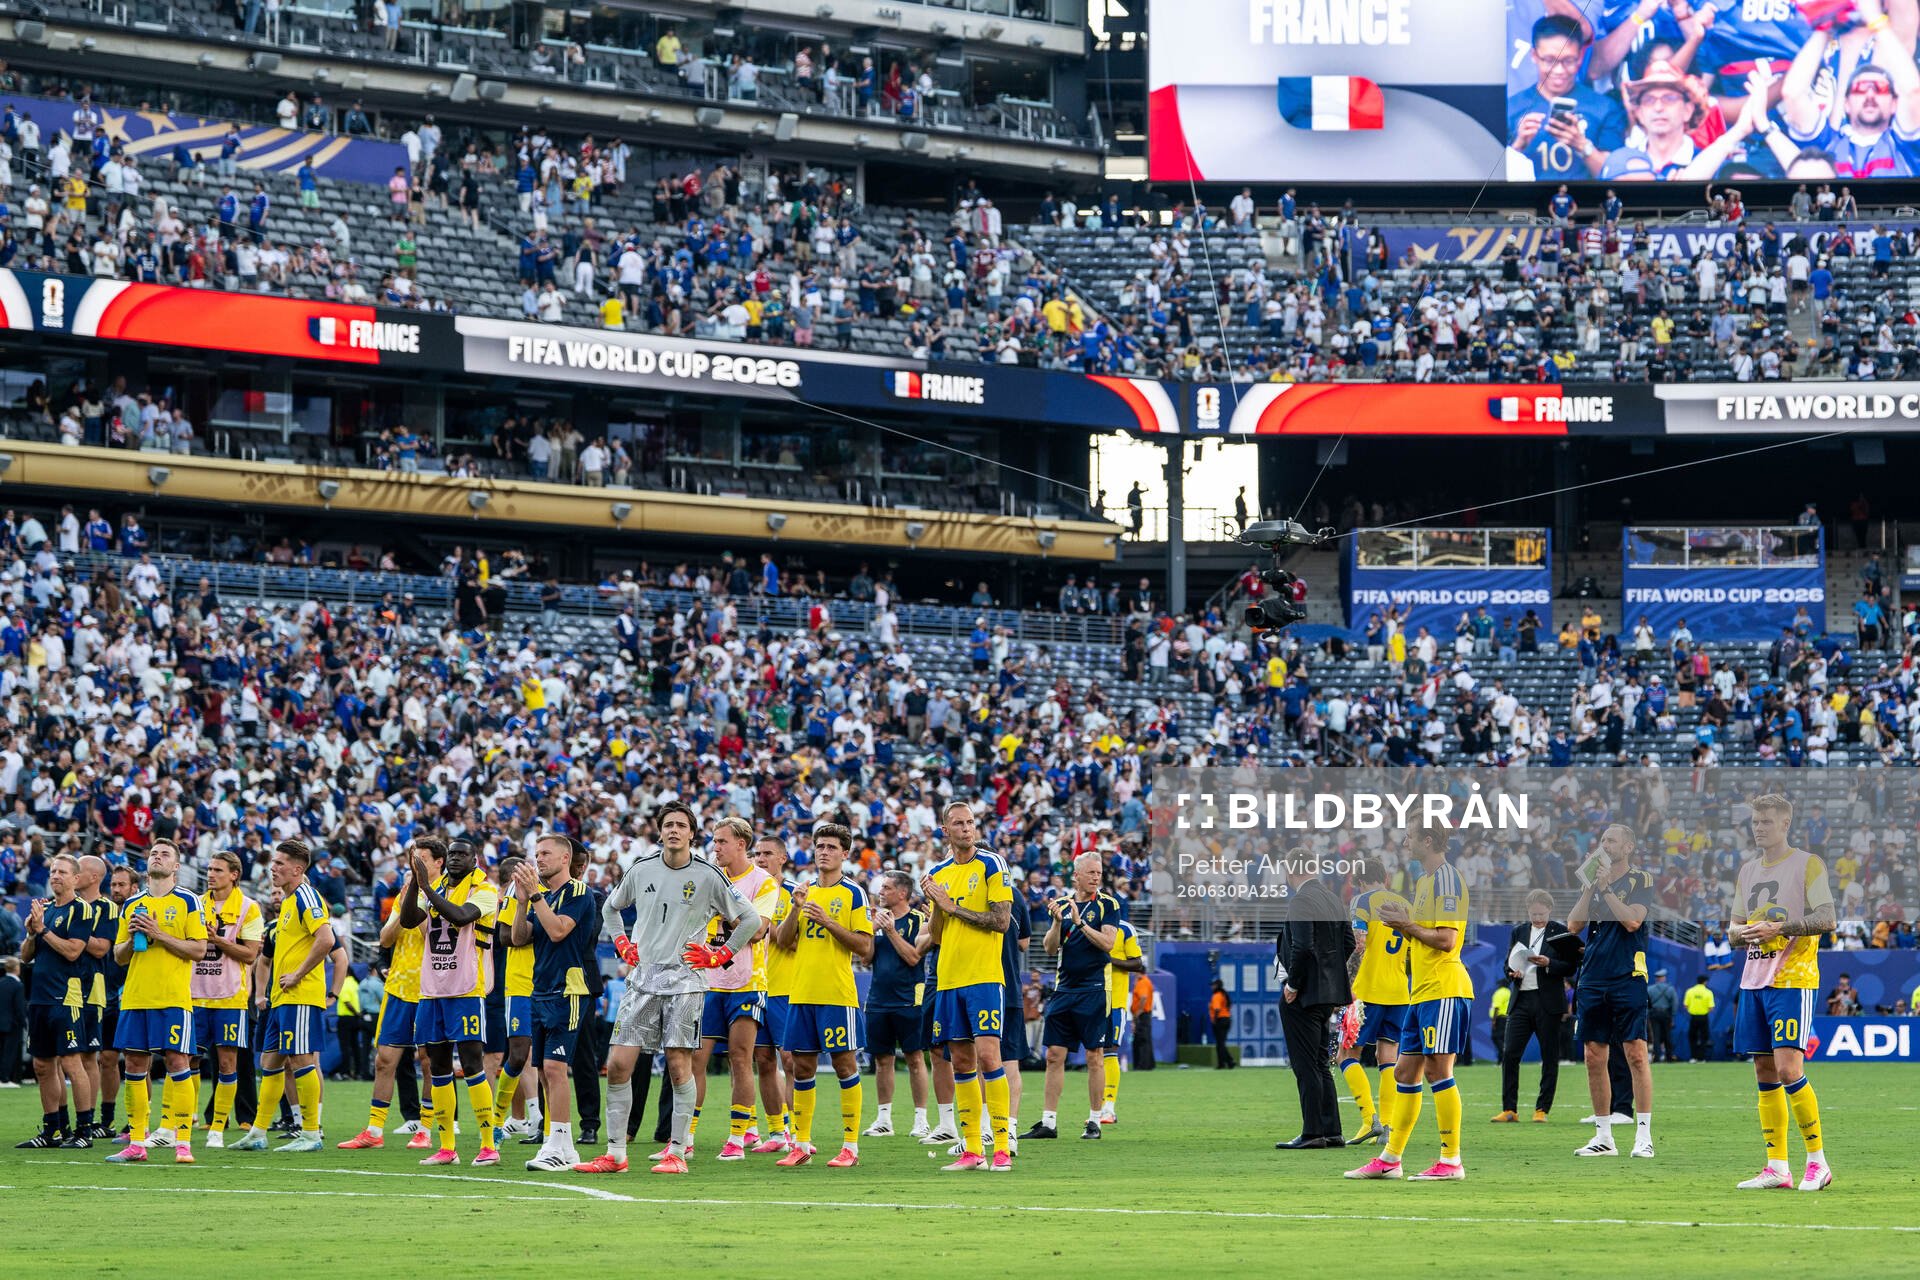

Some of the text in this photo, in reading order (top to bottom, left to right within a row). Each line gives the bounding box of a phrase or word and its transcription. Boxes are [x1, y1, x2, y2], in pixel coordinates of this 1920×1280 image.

[1250, 0, 1411, 45] FRANCE
[1536, 141, 1573, 172] 10
[1618, 232, 1684, 258] FFA
[349, 319, 420, 353] FRANCE
[508, 336, 801, 387] FIFA WORLD CUP 2026
[921, 373, 984, 404] FRANCE
[1534, 396, 1613, 422] FRANCE
[1717, 395, 1785, 420] FIFA
[1787, 394, 1895, 419] WORLD
[1353, 589, 1550, 604] FIFA WORLD CUP 2026
[1626, 588, 1824, 603] FIFA WORLD CUP 2026
[662, 902, 668, 923] 1
[806, 919, 825, 939] 22
[195, 968, 222, 976] 2026
[431, 961, 458, 970] 026
[462, 1015, 479, 1036] 13
[693, 1020, 699, 1040] 1
[978, 1009, 1000, 1030] 25
[1774, 1018, 1798, 1042] 20
[66, 1030, 76, 1040] FL
[169, 1025, 181, 1044] 5
[223, 1023, 237, 1041] 15
[824, 1026, 847, 1048] 22
[1422, 1026, 1436, 1048] 10
[1826, 1024, 1910, 1056] ADI
